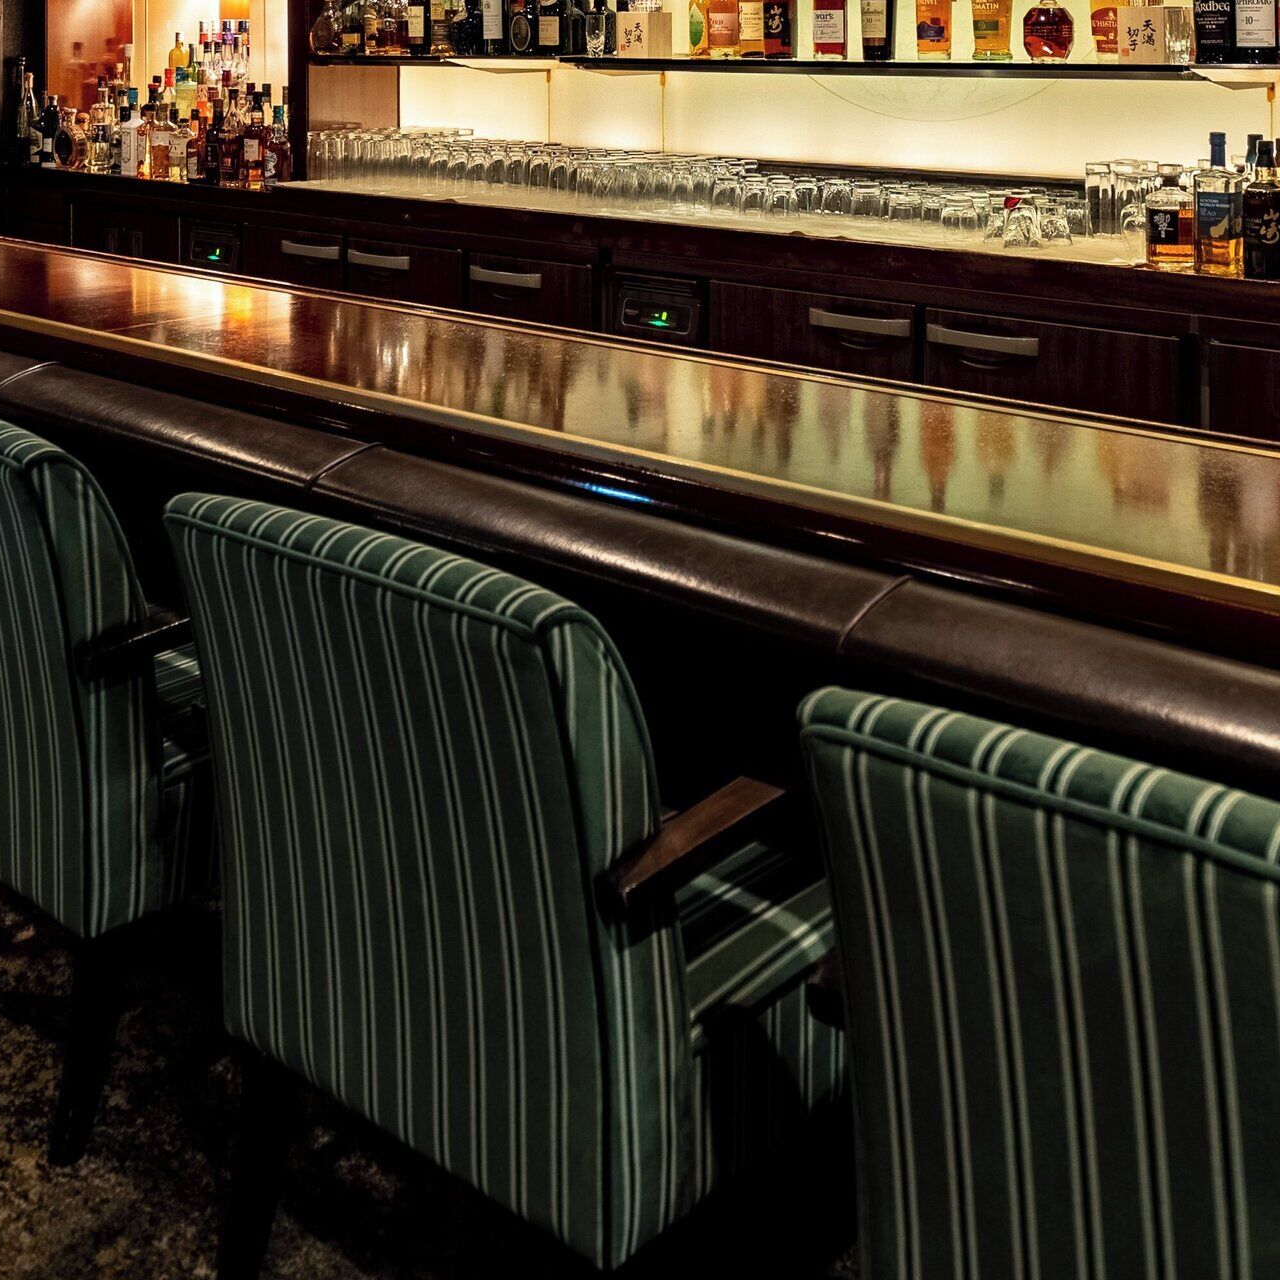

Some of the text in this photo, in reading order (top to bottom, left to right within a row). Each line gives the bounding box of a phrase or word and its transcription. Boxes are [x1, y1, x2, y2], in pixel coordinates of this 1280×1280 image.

[972, 2, 999, 10] OMATIN
[1245, 16, 1253, 25] 10
[1126, 26, 1140, 52] 切子
[1141, 19, 1156, 47] 天満
